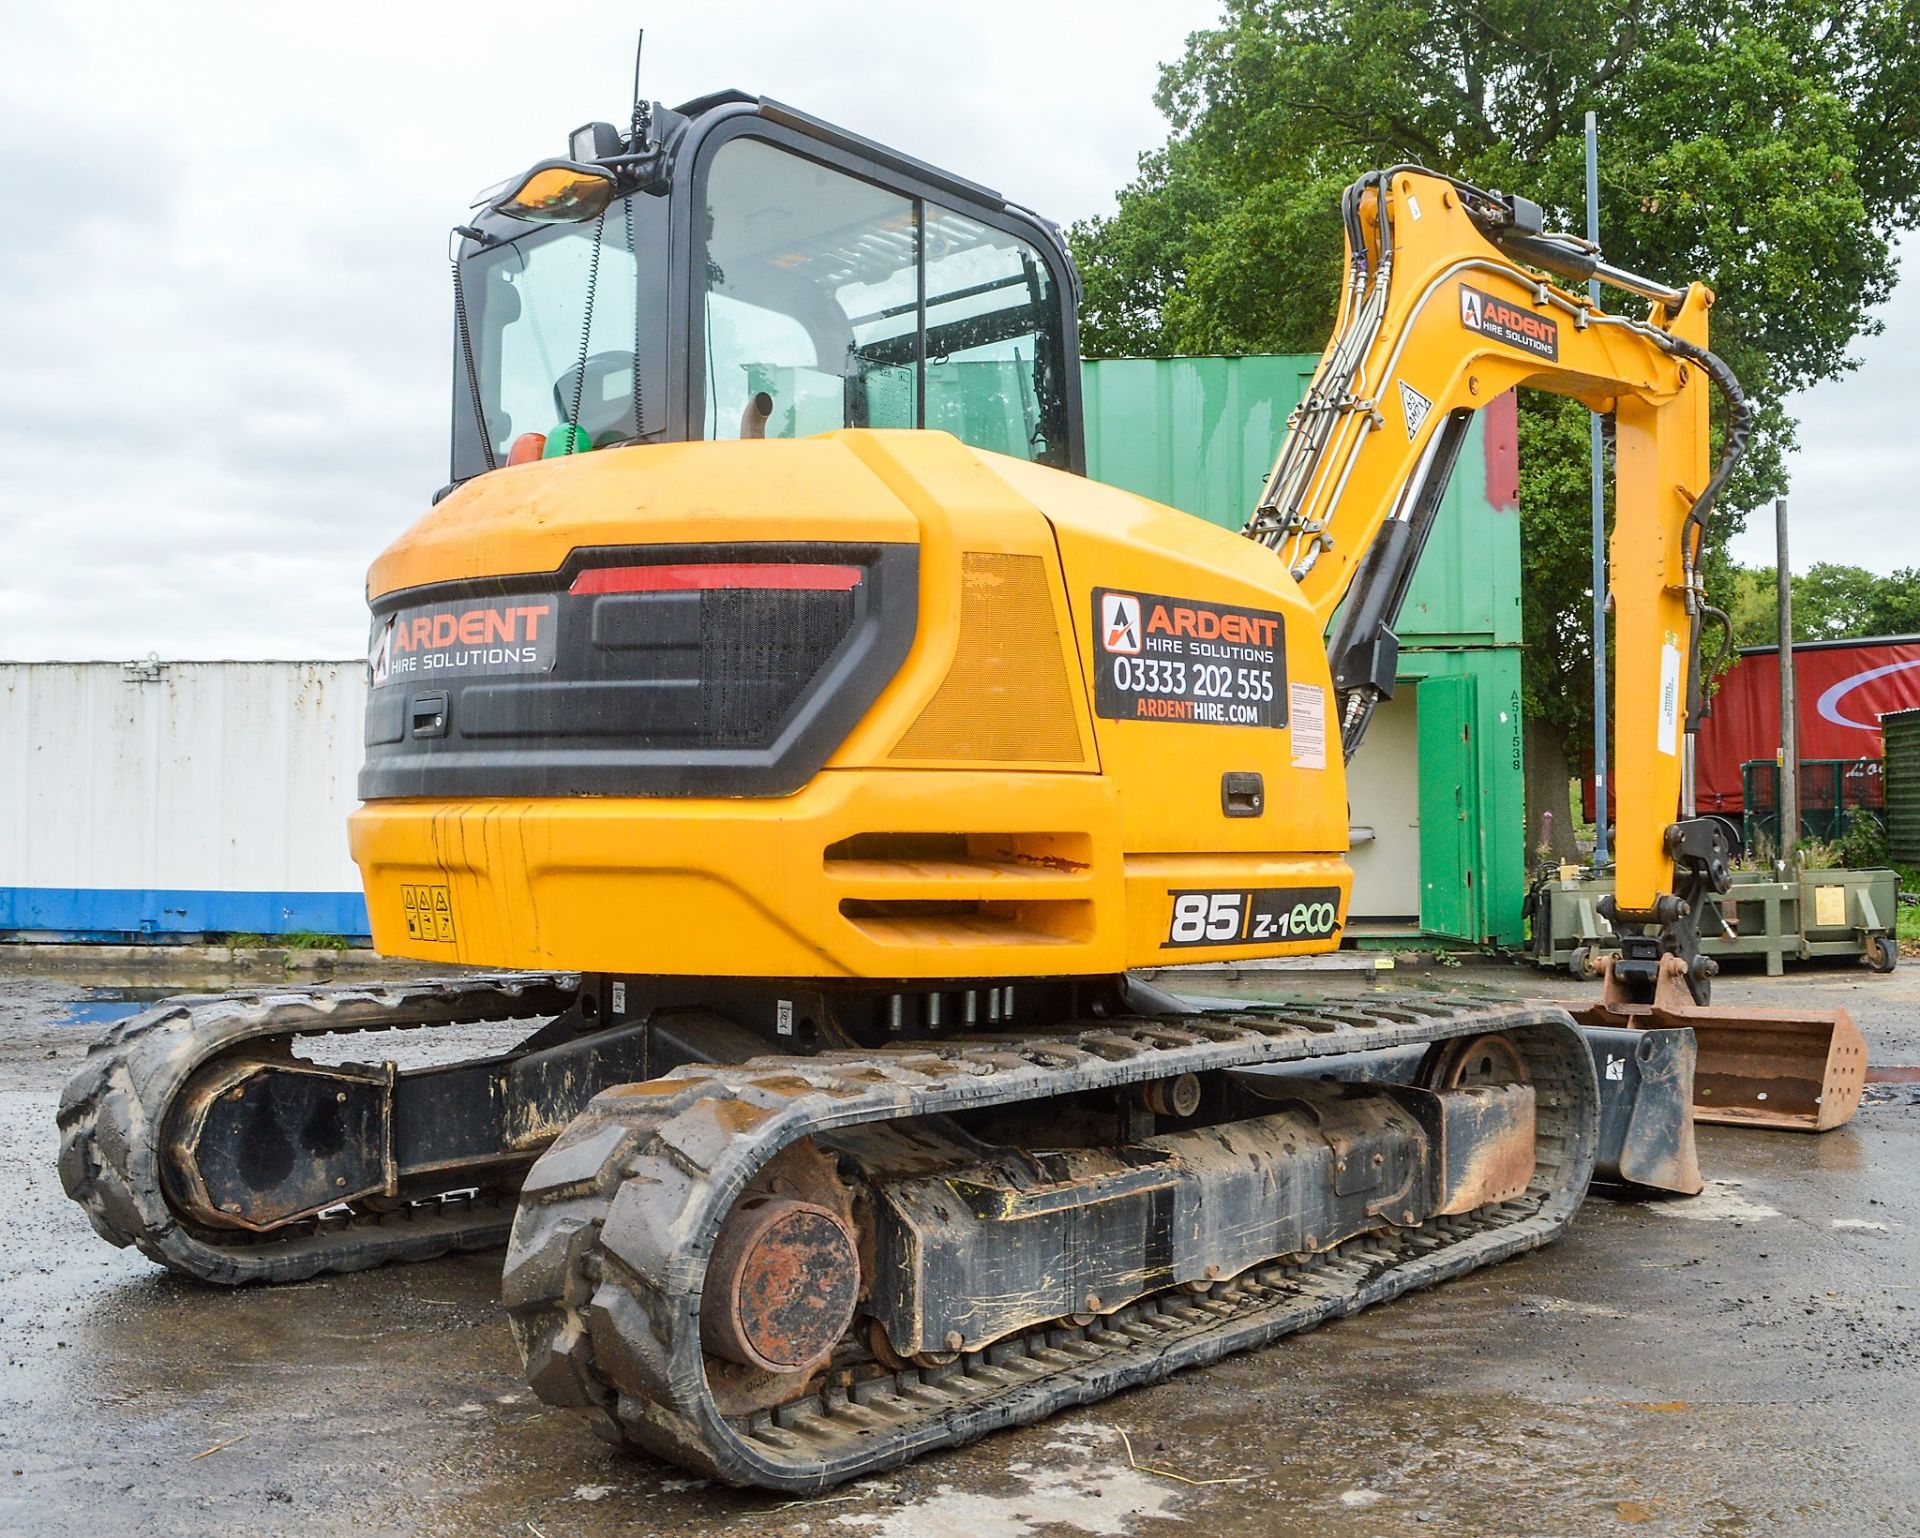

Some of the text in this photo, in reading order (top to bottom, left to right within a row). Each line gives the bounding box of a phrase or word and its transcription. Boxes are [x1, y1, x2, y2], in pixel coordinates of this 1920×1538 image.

[1483, 320, 1553, 354] HIRE SOLUTIONS
[1484, 303, 1555, 344] ARDENT
[392, 606, 549, 655] ARDENT
[1146, 605, 1278, 647] ARDENT
[392, 647, 537, 674] HIRE SOLUTIONS
[1146, 637, 1274, 664] HIRE SOLUTIONS
[1113, 656, 1274, 702] 03333 202 555
[1137, 698, 1258, 724] ARDENTHIRE.COM
[1171, 894, 1242, 942] 85
